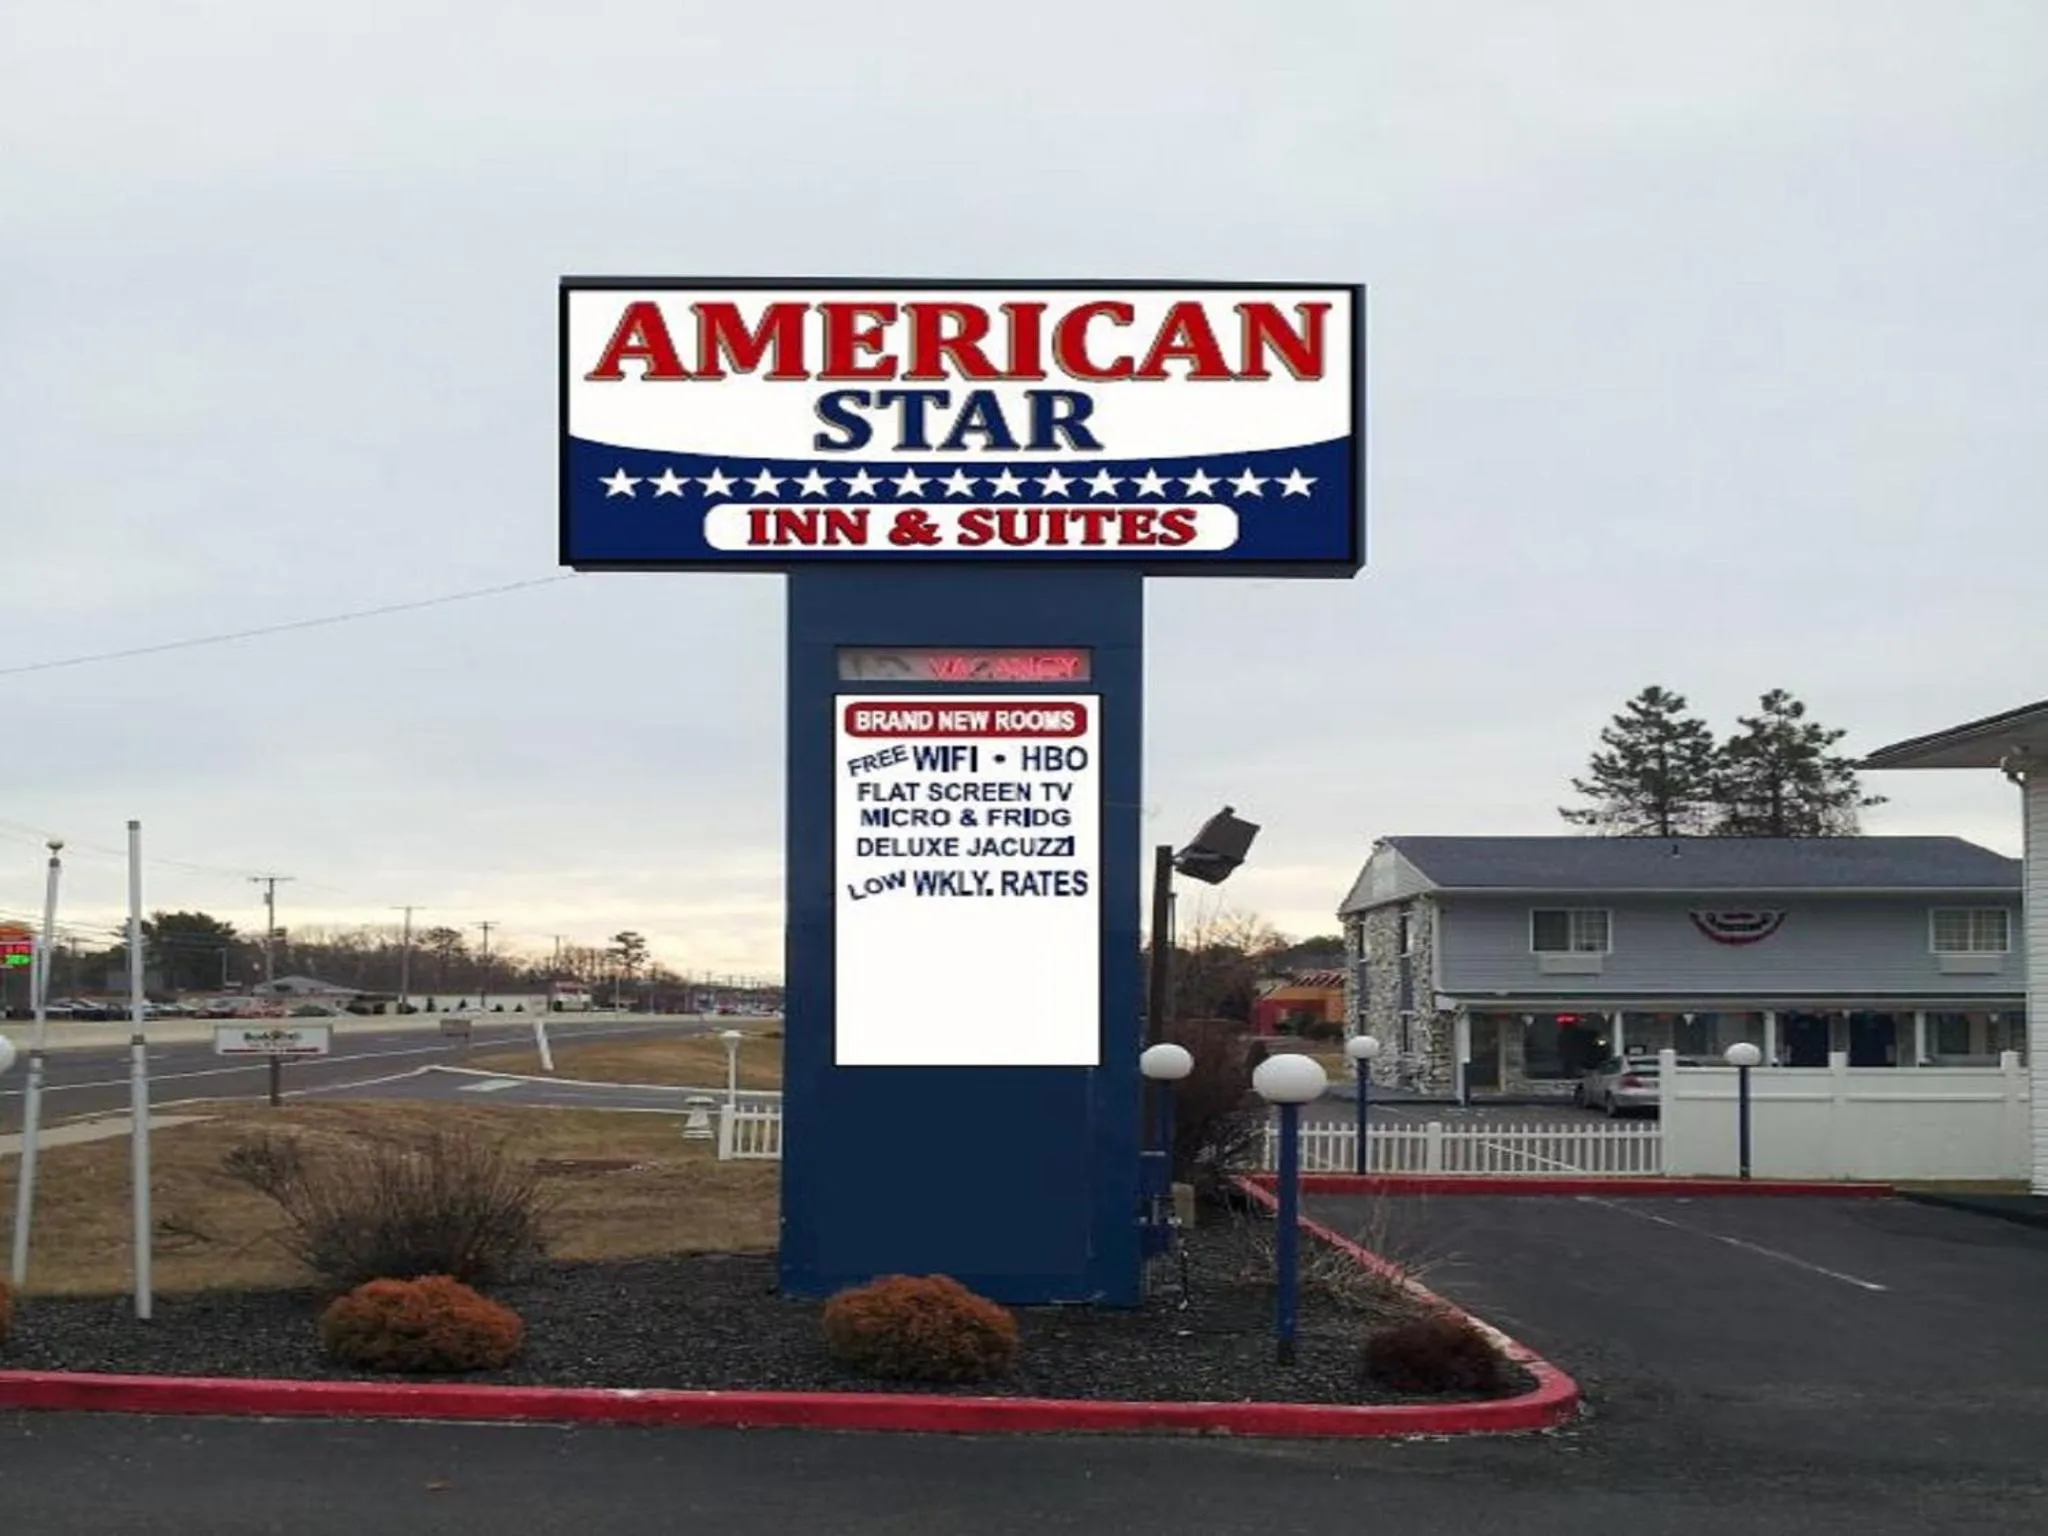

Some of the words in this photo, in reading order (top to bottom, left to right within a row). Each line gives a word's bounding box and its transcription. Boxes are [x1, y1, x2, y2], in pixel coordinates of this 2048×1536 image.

[584, 301, 1332, 383] AMERICAN
[814, 389, 1104, 452] STAR
[747, 508, 870, 546] INN
[888, 508, 942, 546] &
[958, 508, 1197, 546] SUITES
[855, 710, 934, 731] BRAND
[938, 710, 990, 731] NEW
[995, 710, 1076, 731] ROOMS
[848, 744, 908, 777] FREE
[913, 745, 978, 773] WIFI
[1022, 745, 1089, 773] HBO
[858, 783, 921, 802] FLAT
[928, 782, 1032, 802] SCREEN
[1040, 783, 1073, 802] TV
[860, 807, 951, 828] MICRO
[959, 809, 978, 827] &
[987, 807, 1071, 828] FRIDG
[857, 837, 959, 857] DELUXE
[966, 836, 1075, 857] JACUZZI
[847, 870, 906, 901] LOW
[914, 870, 994, 897] WKLY.
[1001, 870, 1089, 897] RATES
